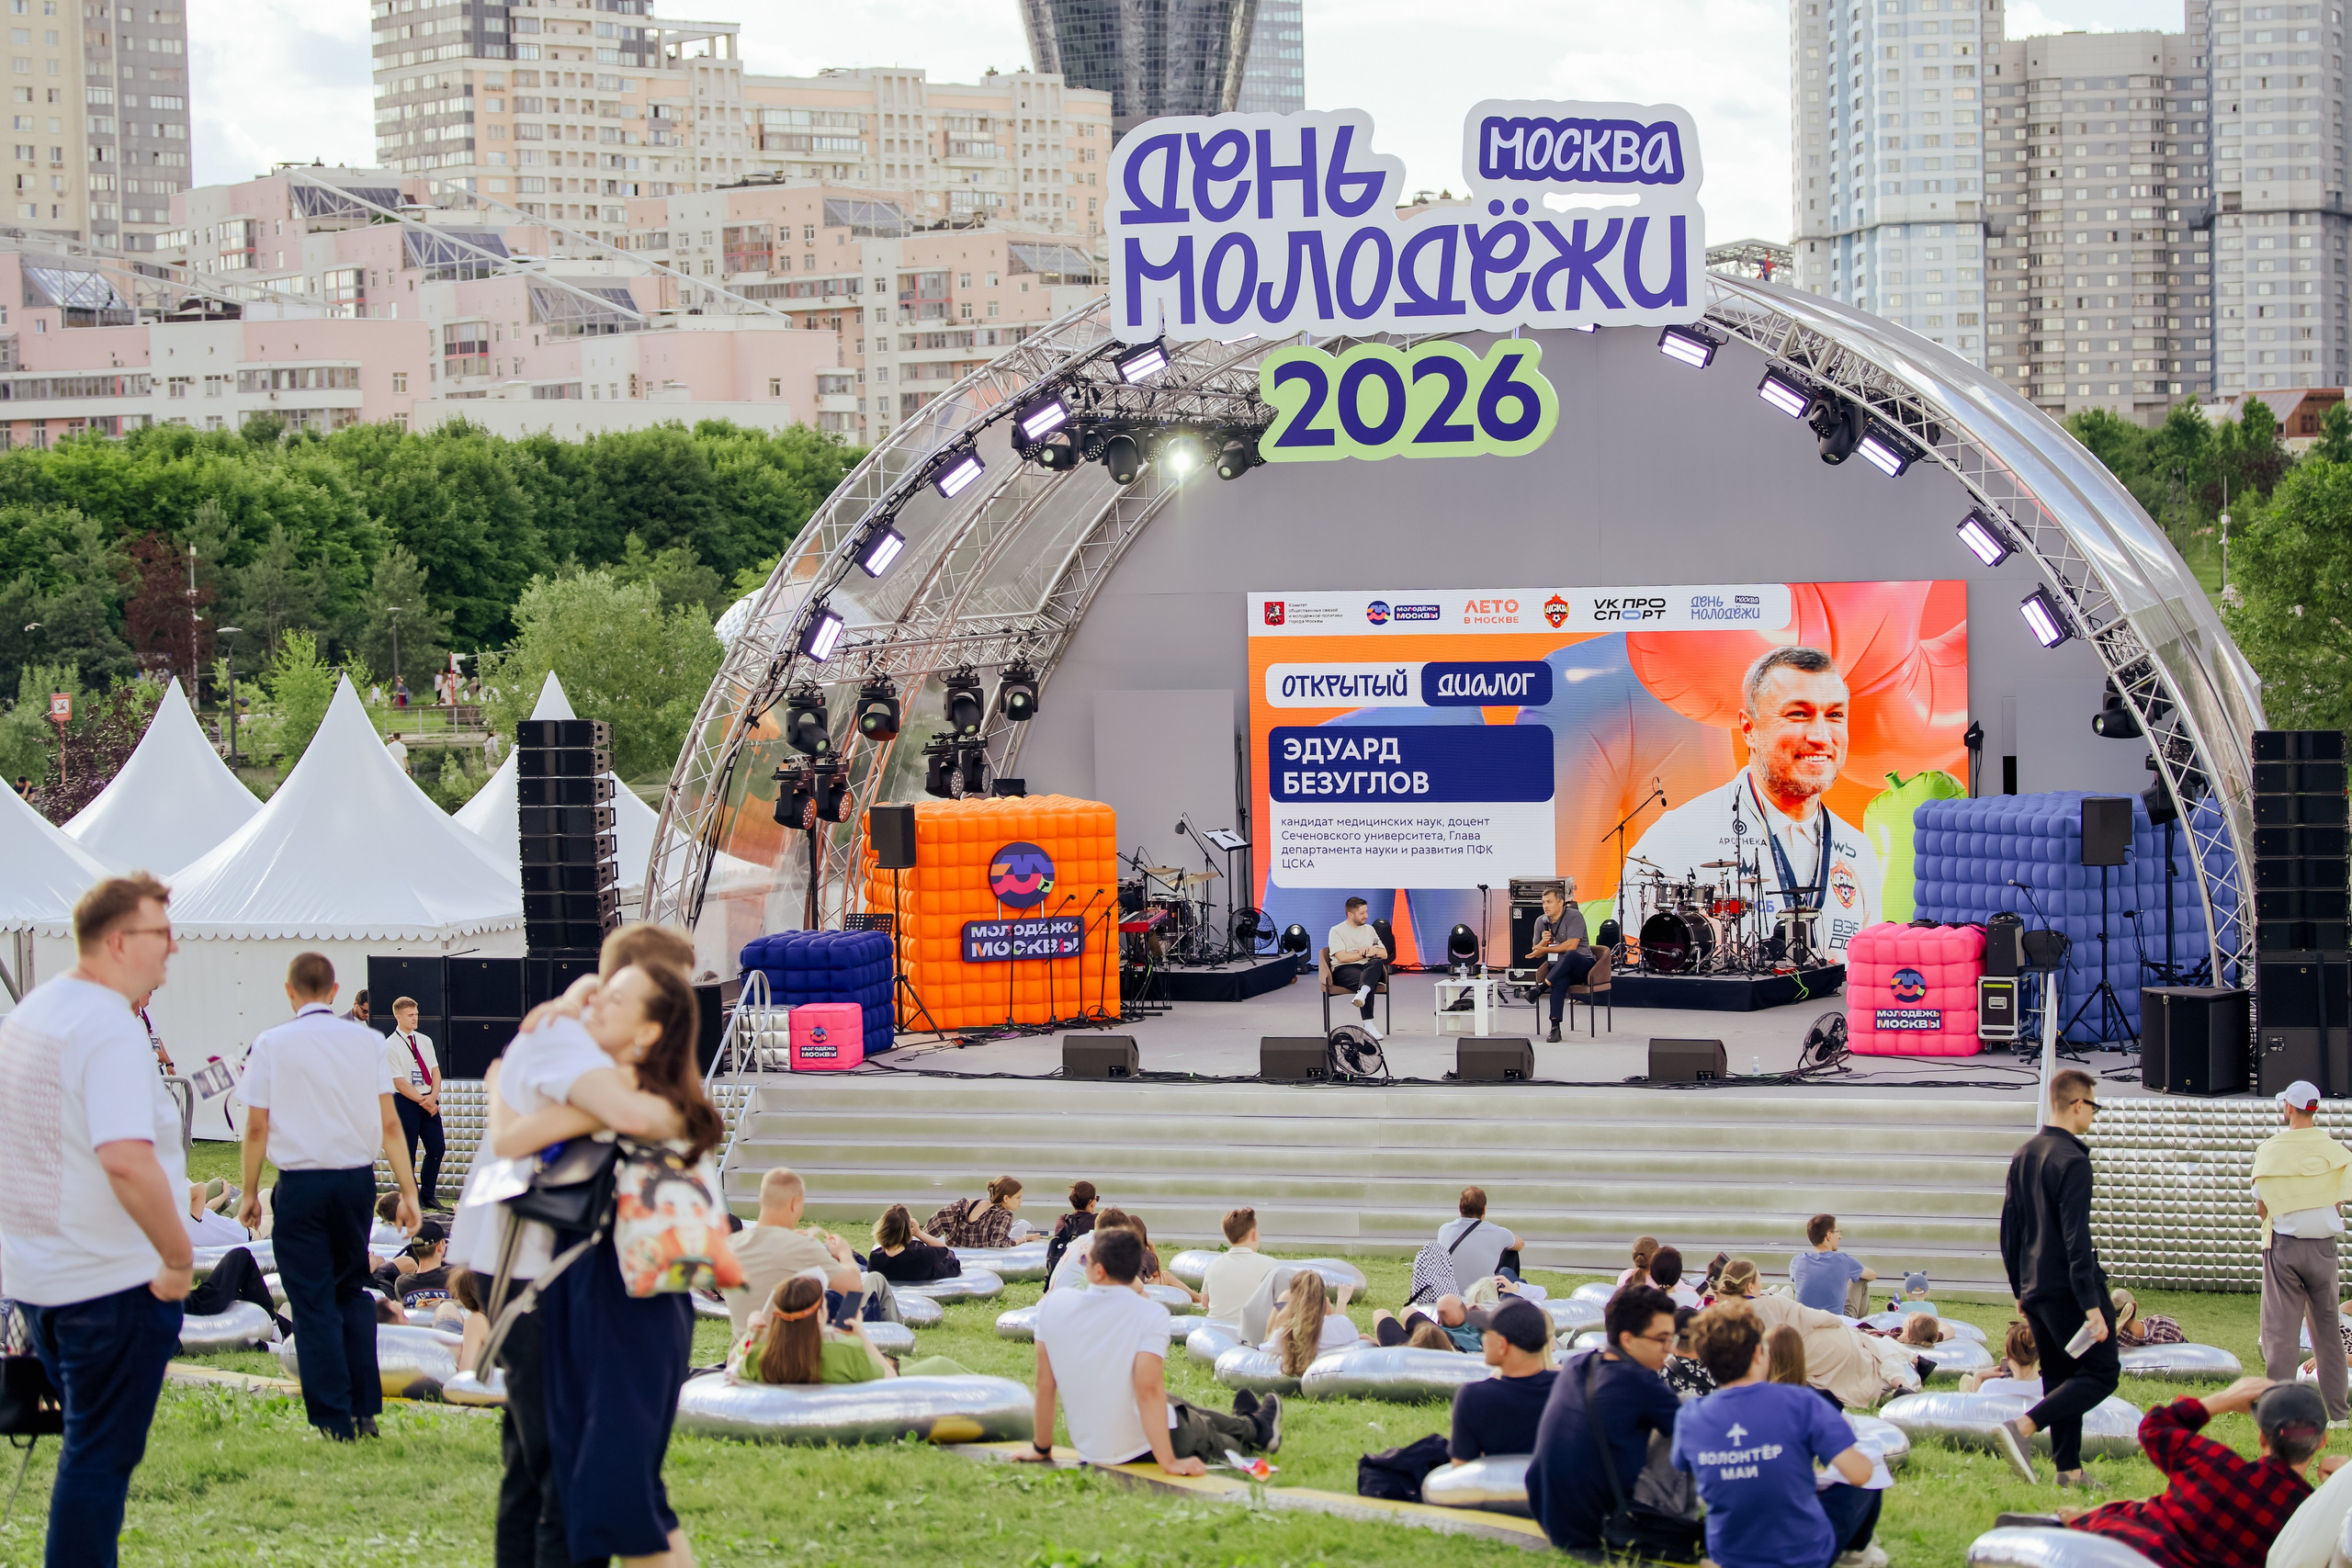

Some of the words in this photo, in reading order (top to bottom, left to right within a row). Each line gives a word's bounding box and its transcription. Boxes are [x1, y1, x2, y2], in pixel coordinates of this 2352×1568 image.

[1488, 126, 1675, 175] МОСКВА
[1272, 354, 1542, 447] 2026
[1464, 599, 1520, 614] ЛЕТО
[1594, 599, 1619, 609] VK
[1622, 598, 1667, 609] ПРО
[1593, 609, 1667, 620] СПОРТ
[1282, 669, 1408, 698] ОТКРЫТЫЙ
[1438, 672, 1536, 696] ДИАЛОГ
[1283, 738, 1401, 764] ЭДУАРД
[1283, 772, 1430, 795] БЕЗУГЛОВ
[1281, 818, 1334, 827] кандидат
[1337, 818, 1413, 827] медицинских
[1416, 818, 1445, 829] наук,
[1447, 818, 1490, 828] доцент
[1281, 831, 1361, 840] Сеченовского
[1363, 832, 1446, 843] университета,
[1449, 831, 1481, 840] Глава
[1281, 845, 1363, 856] департамента
[1365, 845, 1398, 856] науки
[1401, 845, 1408, 854] и
[1411, 845, 1464, 856] развития
[1466, 845, 1494, 854] ПФК
[1282, 859, 1315, 870] ЦСКА
[971, 920, 1079, 938] МОЛОДЁЖЬ
[1833, 919, 1860, 935] ВЭБ
[971, 937, 1080, 957] МОСКВЫ
[1877, 1020, 1940, 1029] МОСКВЫ
[1698, 1444, 1783, 1465] ВОЛОНТЁР
[1721, 1466, 1758, 1481] МАИ
